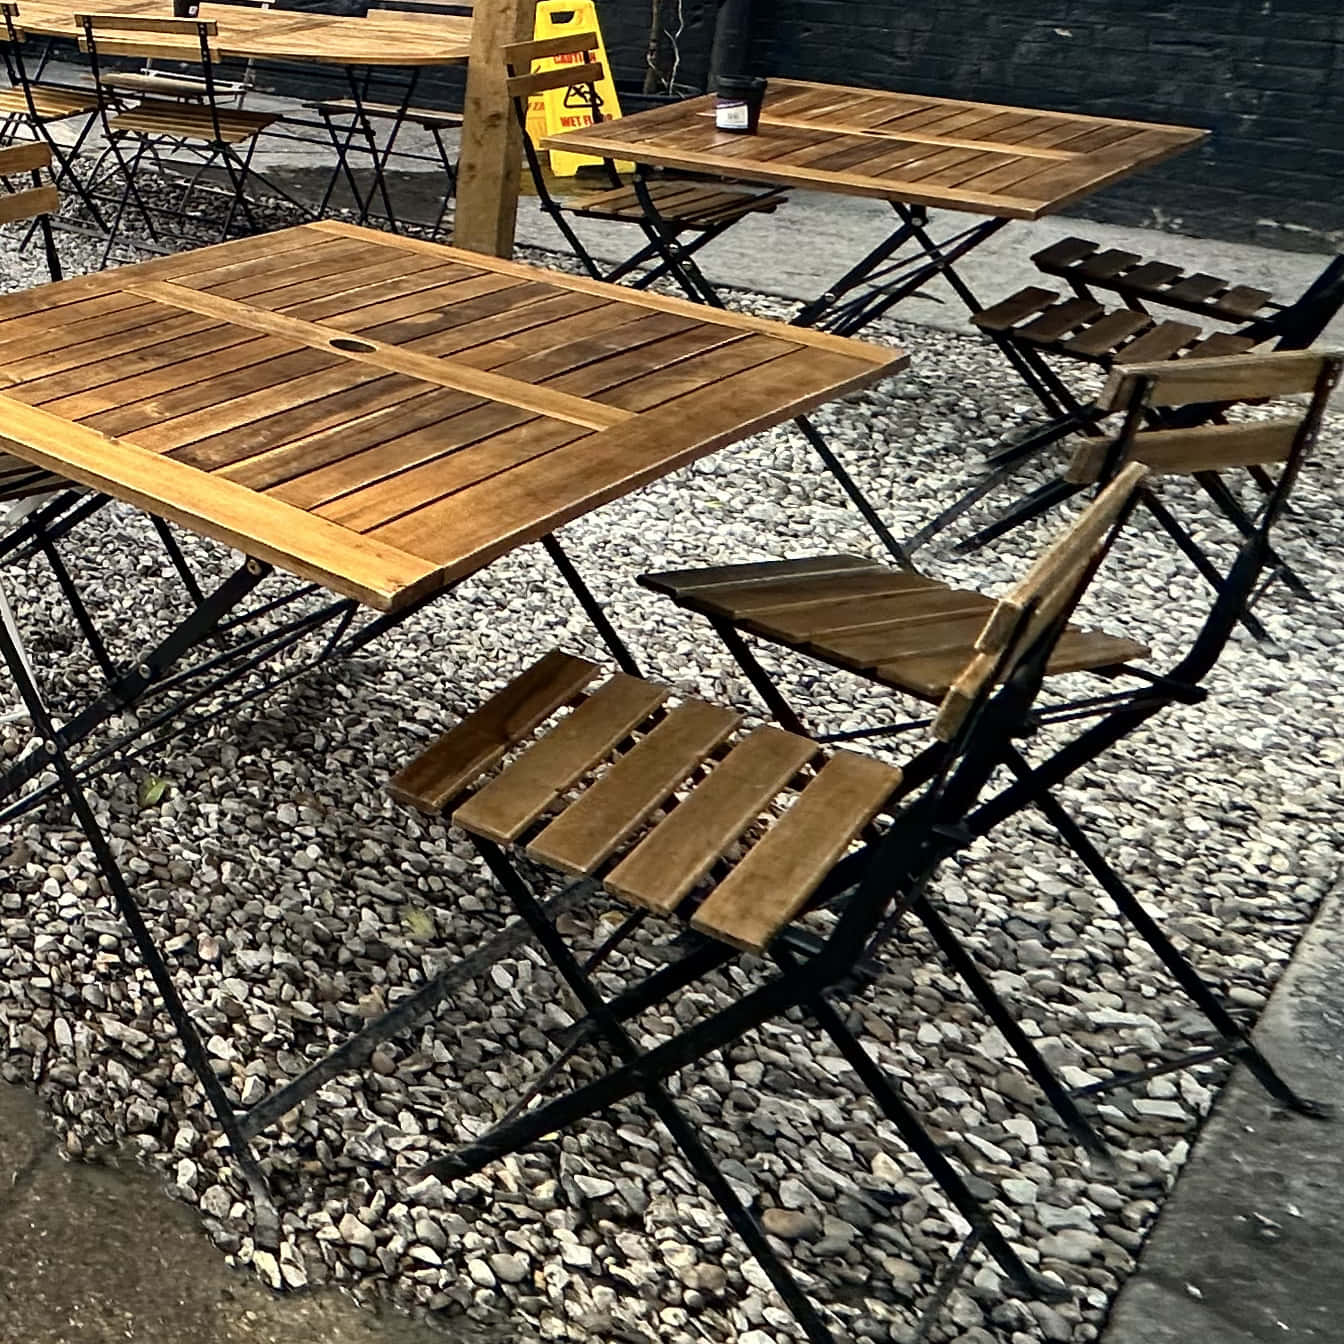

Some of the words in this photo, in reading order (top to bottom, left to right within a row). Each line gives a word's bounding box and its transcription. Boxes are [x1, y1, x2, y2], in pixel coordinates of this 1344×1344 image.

[553, 51, 597, 64] CAUTIN
[560, 116, 582, 127] WET
[583, 113, 613, 127] FLR
